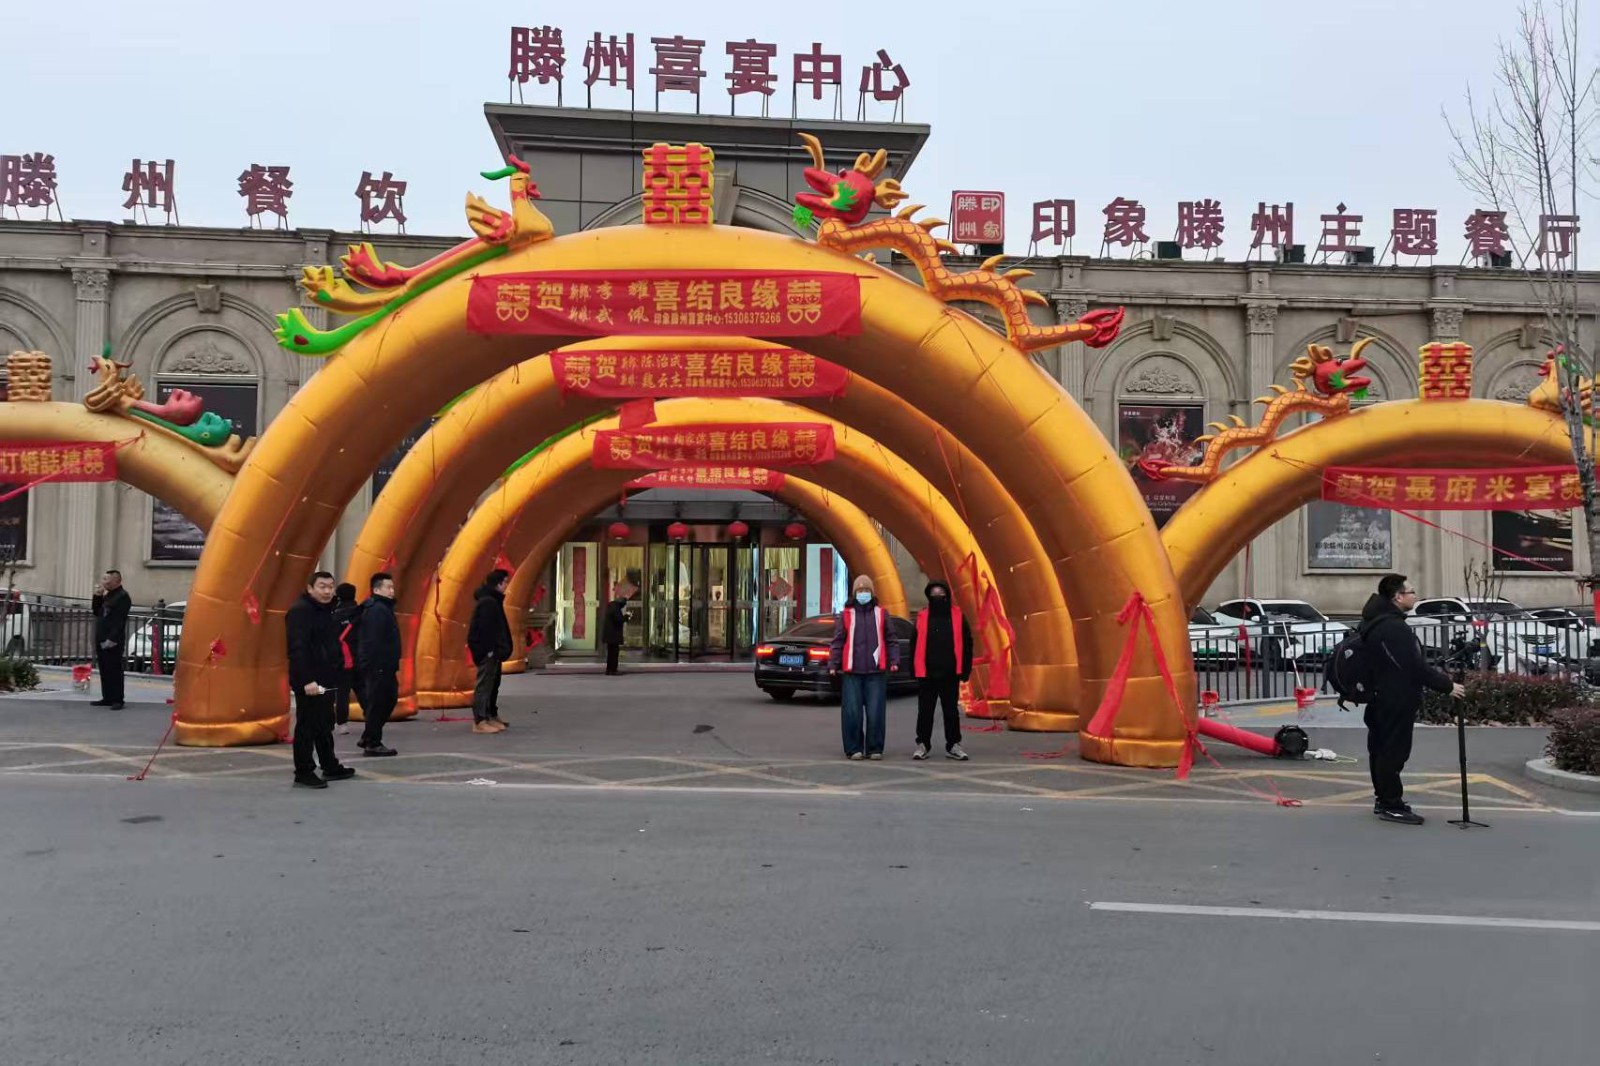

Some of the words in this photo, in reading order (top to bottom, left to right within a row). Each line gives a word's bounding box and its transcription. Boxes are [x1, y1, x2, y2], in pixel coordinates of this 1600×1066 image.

[509, 25, 910, 101] 滕州喜宴中心
[0, 152, 407, 224] 滕州餐饮
[1032, 196, 1580, 259] 印象滕州主题餐厅
